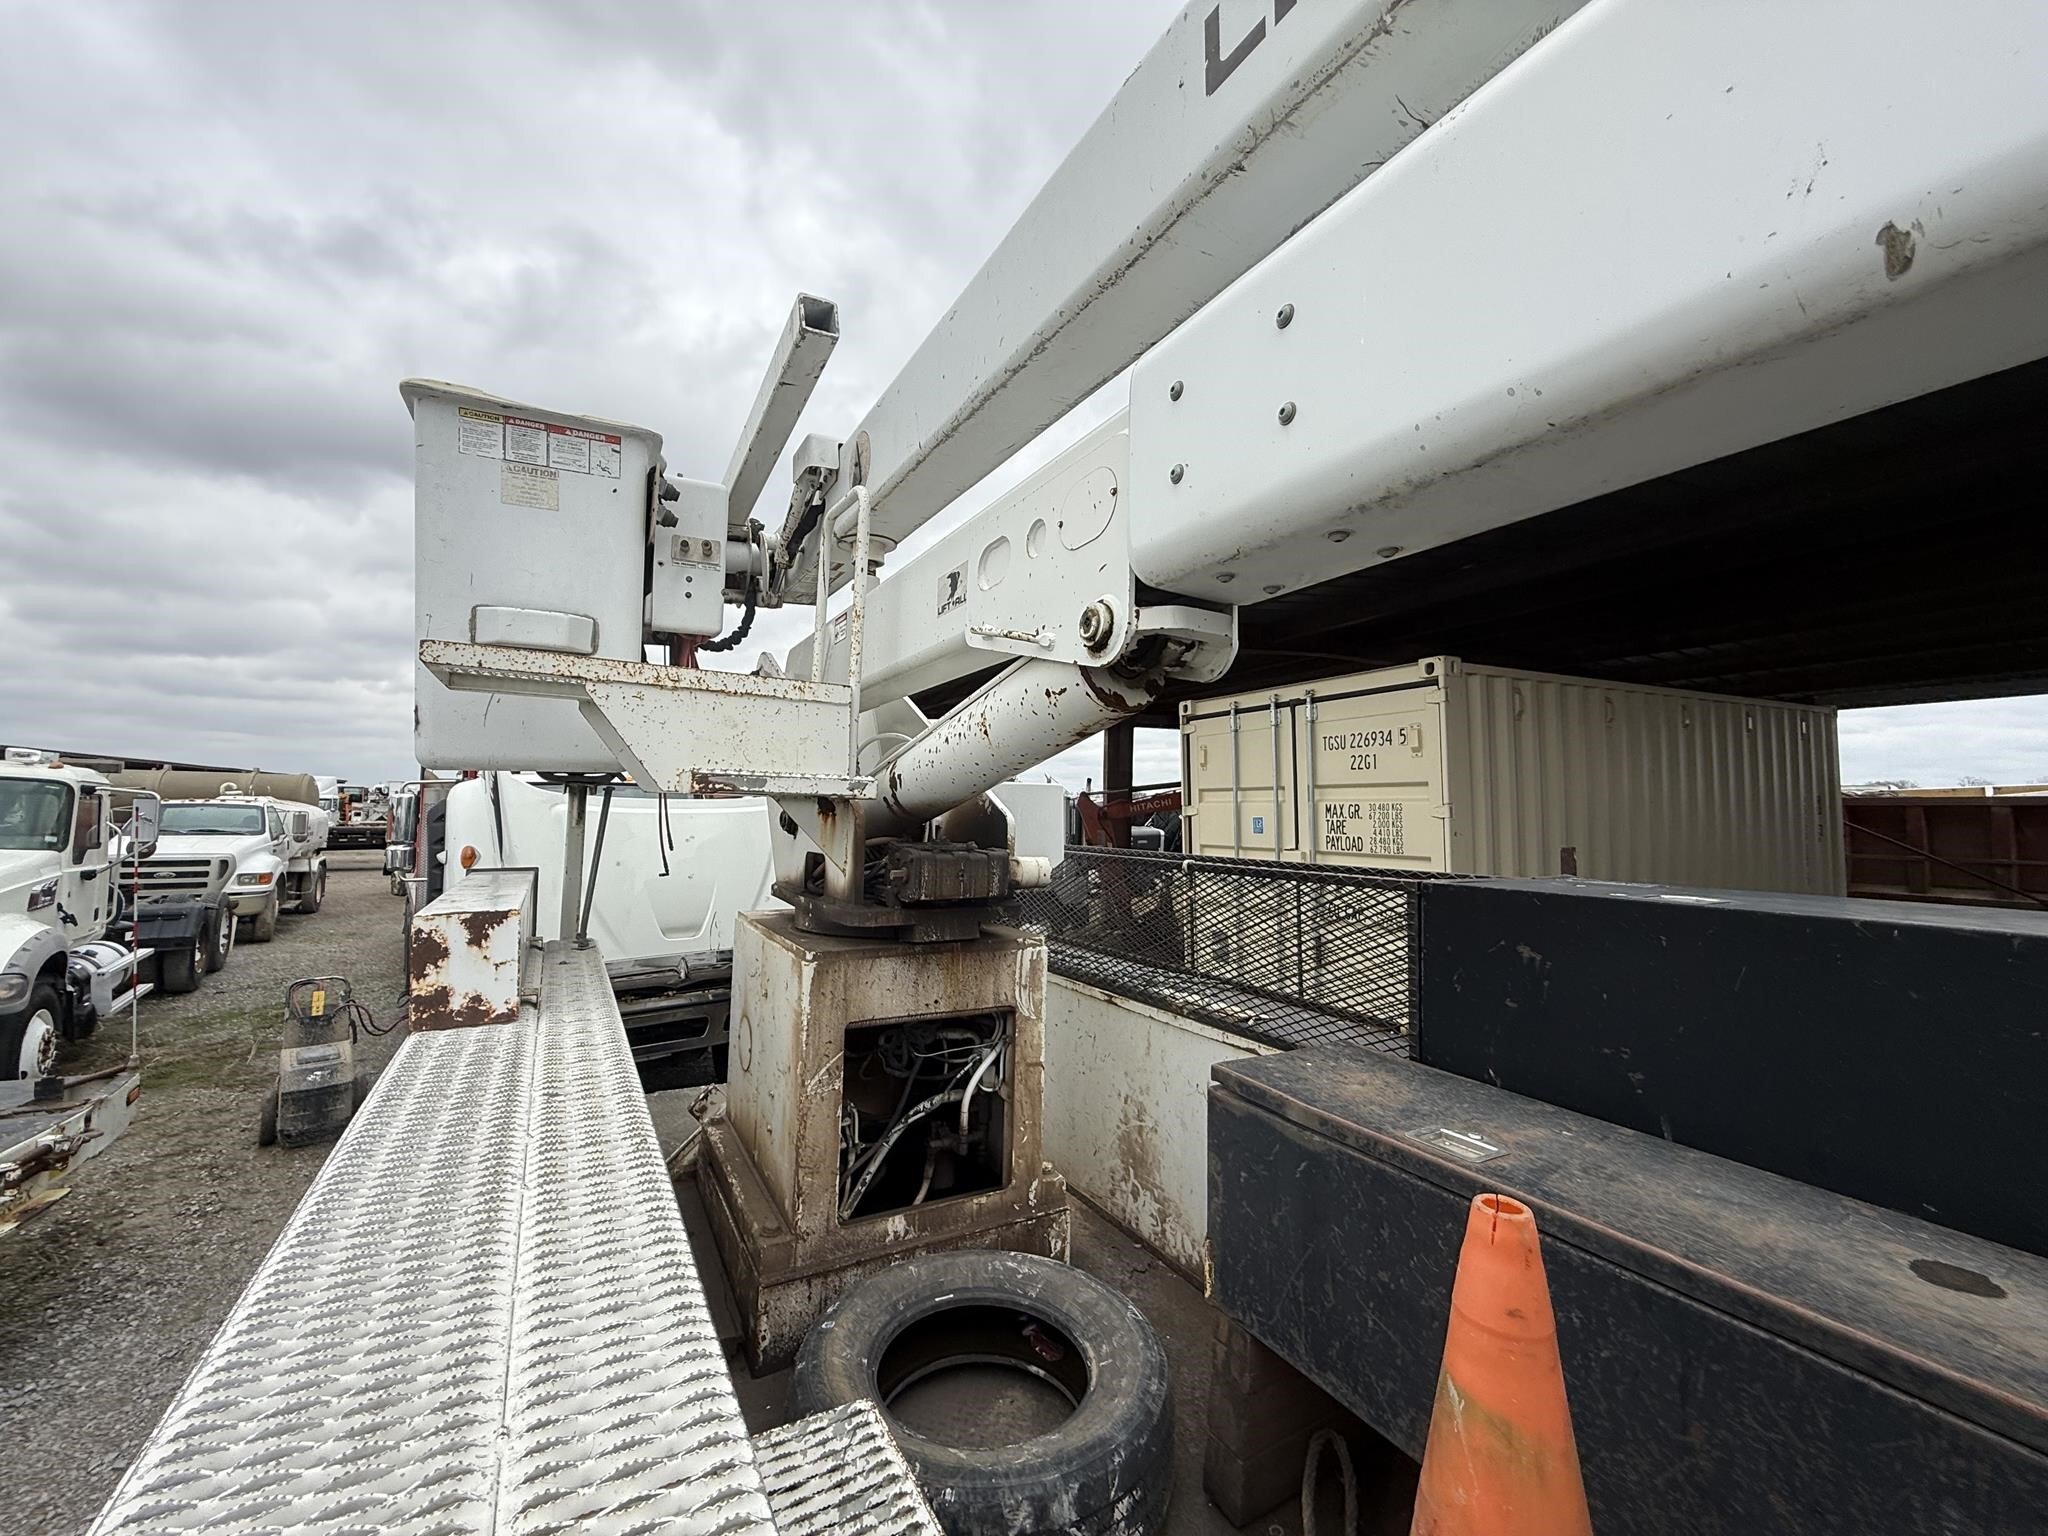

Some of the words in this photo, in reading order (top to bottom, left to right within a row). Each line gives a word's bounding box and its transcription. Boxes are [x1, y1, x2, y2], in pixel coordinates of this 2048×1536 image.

[468, 411, 500, 422] CAUTION
[515, 419, 546, 430] DANGER
[572, 429, 606, 442] DANGER
[512, 464, 558, 479] CAUTION
[1322, 734, 1347, 752] TGSU
[1349, 729, 1393, 749] 226934
[1399, 727, 1407, 746] 5
[1350, 753, 1377, 770] 22G1
[1129, 798, 1172, 813] HITACHI
[1391, 803, 1403, 811] KGS
[1391, 811, 1403, 820] LBS
[1325, 819, 1347, 835] TARE
[1391, 820, 1403, 828] KGS
[1391, 829, 1404, 838] LBS
[1325, 835, 1364, 852] PAYLOAD
[1392, 837, 1404, 846] KGS
[1392, 845, 1405, 855] LBS
